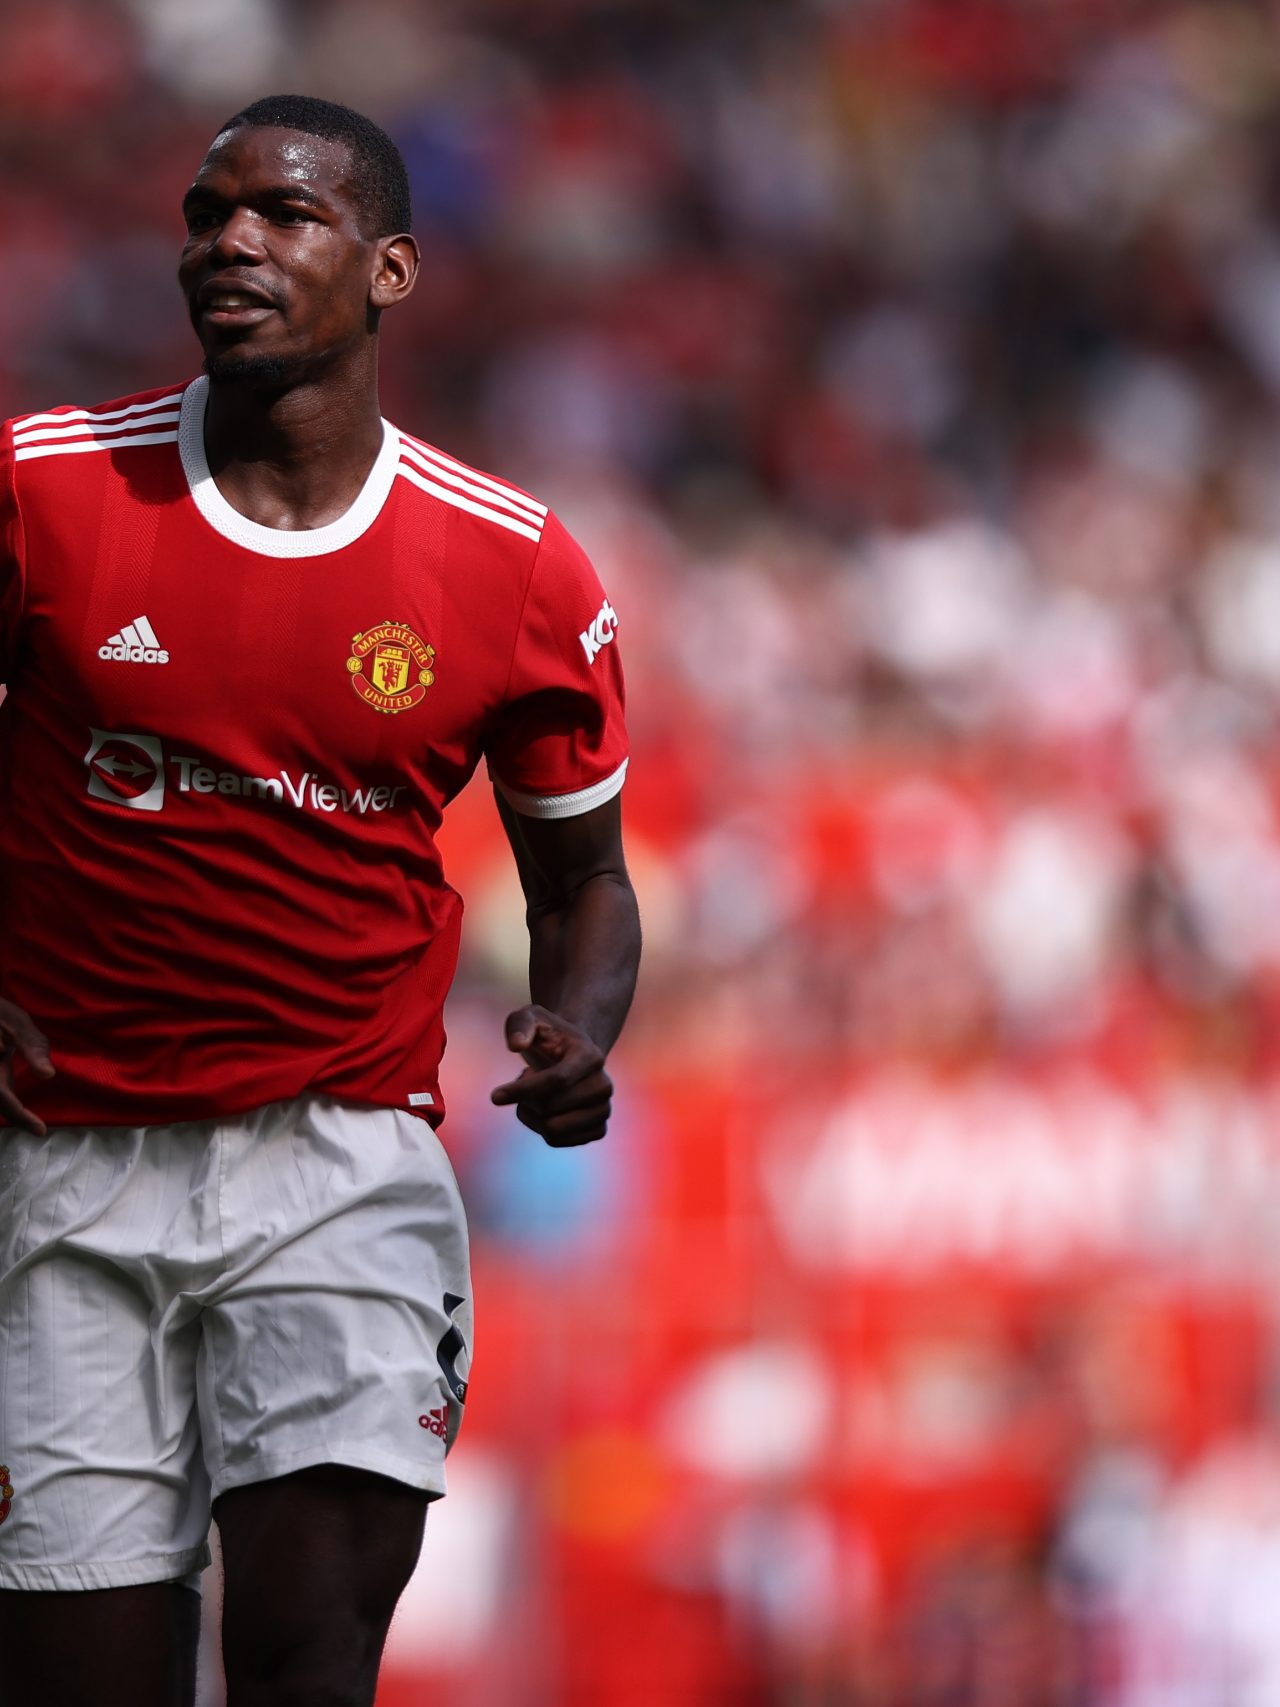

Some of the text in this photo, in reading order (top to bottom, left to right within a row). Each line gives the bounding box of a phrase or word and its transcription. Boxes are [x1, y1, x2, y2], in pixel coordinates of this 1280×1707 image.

[98, 643, 170, 664] adidas
[358, 628, 428, 662] MANCHESTER
[364, 688, 412, 708] UNITED
[170, 755, 407, 814] TeamViewer
